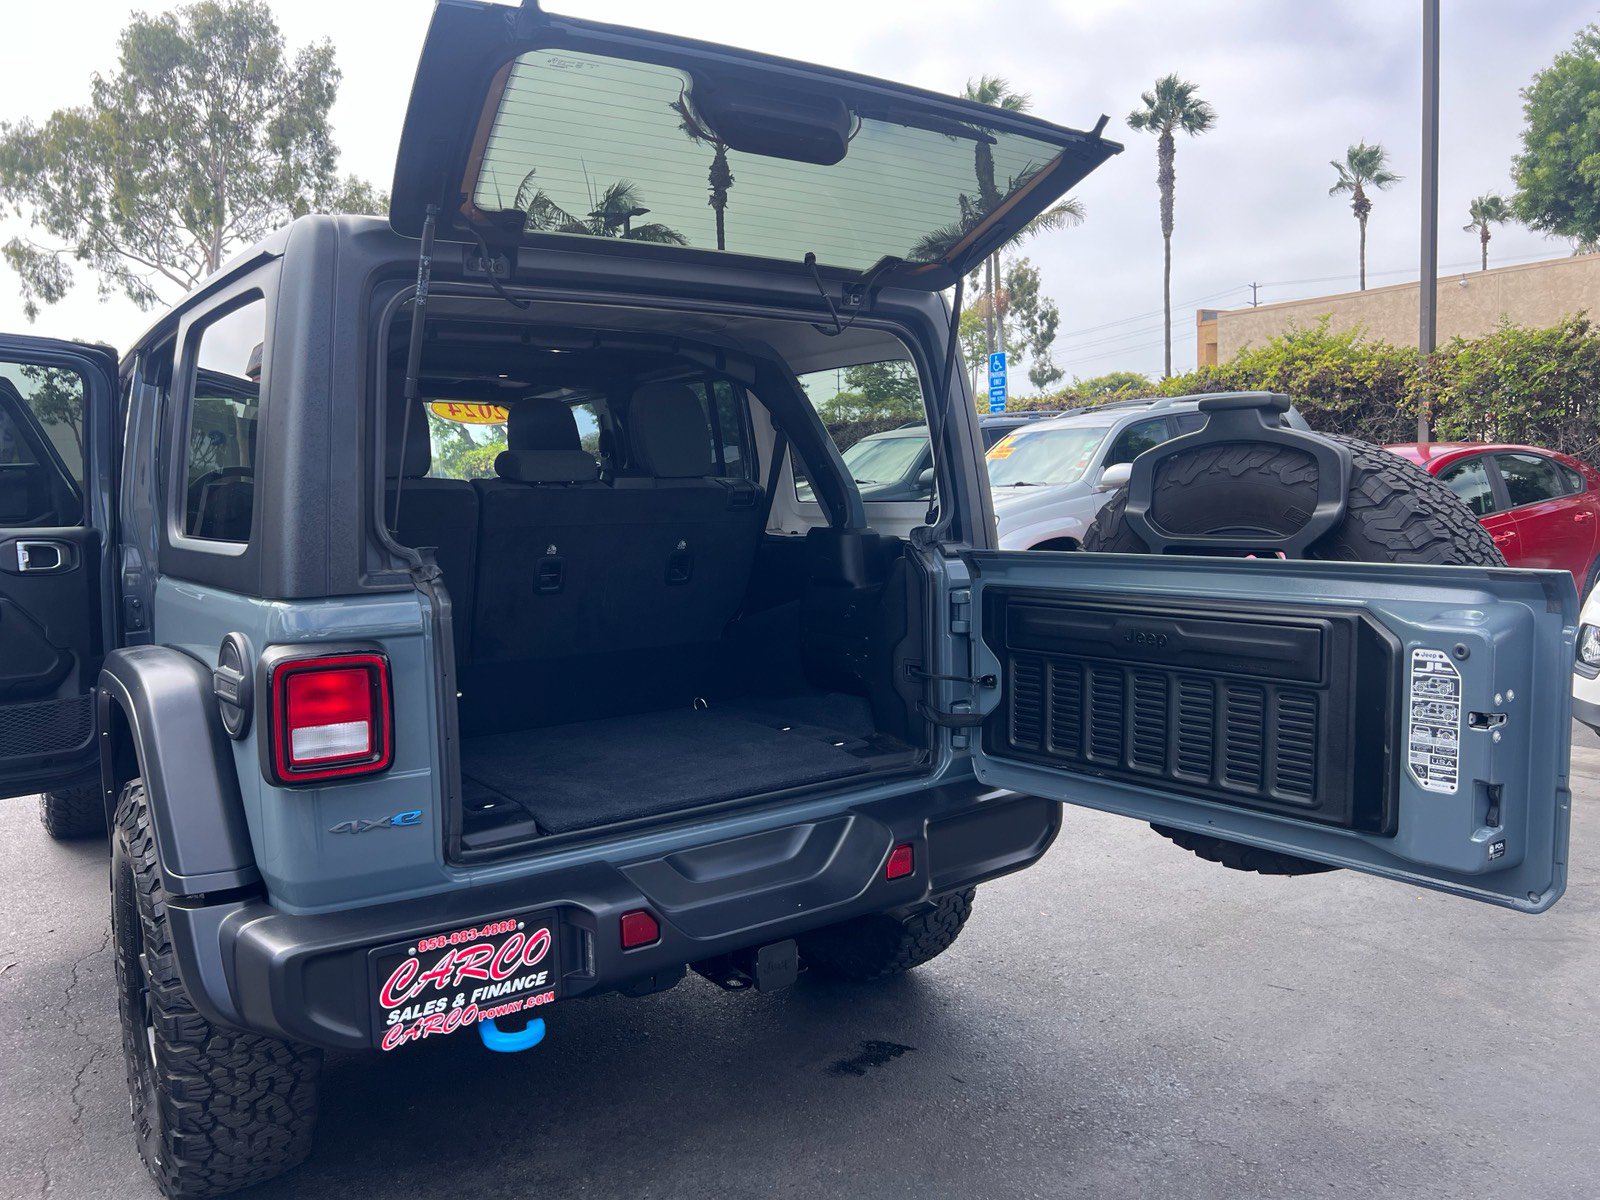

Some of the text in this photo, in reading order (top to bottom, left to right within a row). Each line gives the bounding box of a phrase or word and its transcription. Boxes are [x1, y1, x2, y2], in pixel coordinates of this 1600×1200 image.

[1122, 628, 1168, 648] Jeep
[417, 919, 517, 953] 858-883-4888
[379, 928, 552, 1009] CARCO
[386, 970, 548, 1025] SALES & FINANCE
